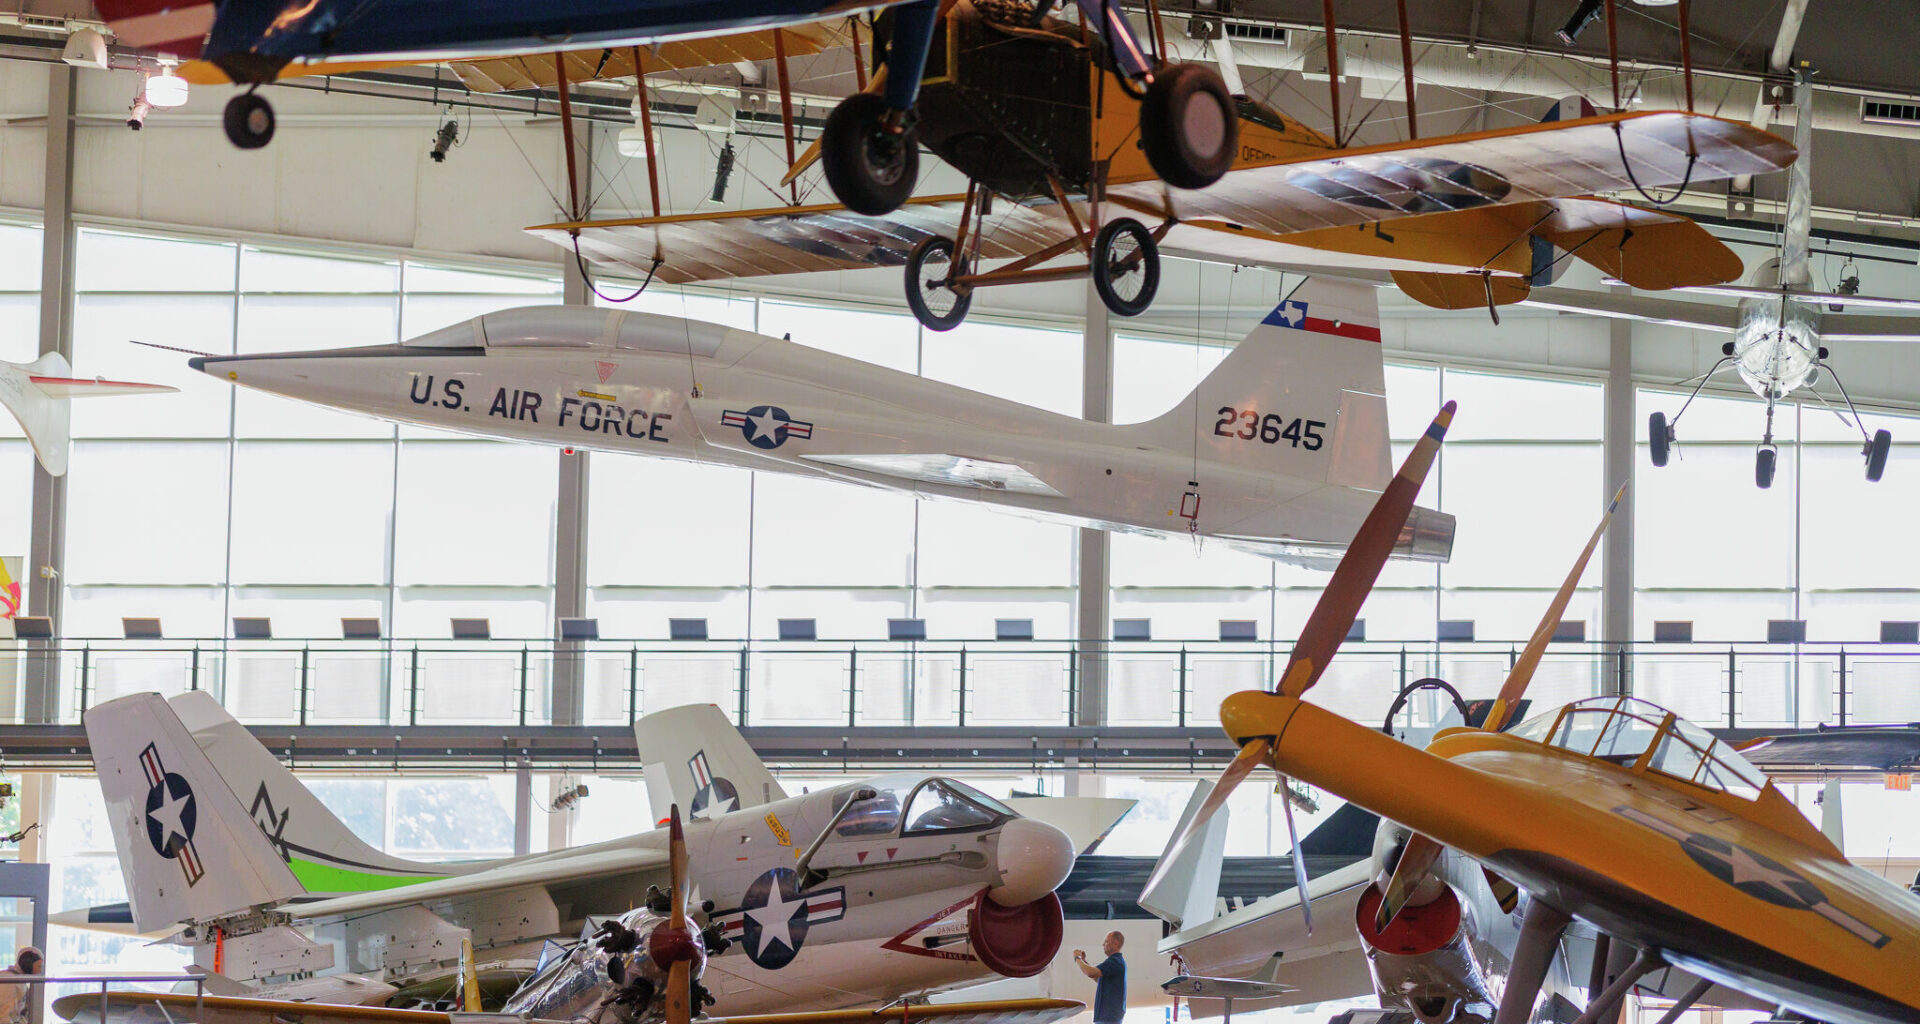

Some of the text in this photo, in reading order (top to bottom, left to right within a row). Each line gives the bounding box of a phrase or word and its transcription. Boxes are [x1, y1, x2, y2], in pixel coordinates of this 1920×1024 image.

[410, 375, 672, 443] U.S. AIR FORCE
[1214, 406, 1327, 451] 23645
[1888, 775, 1909, 789] EXIT
[937, 908, 951, 920] JET
[936, 924, 966, 935] DANGER
